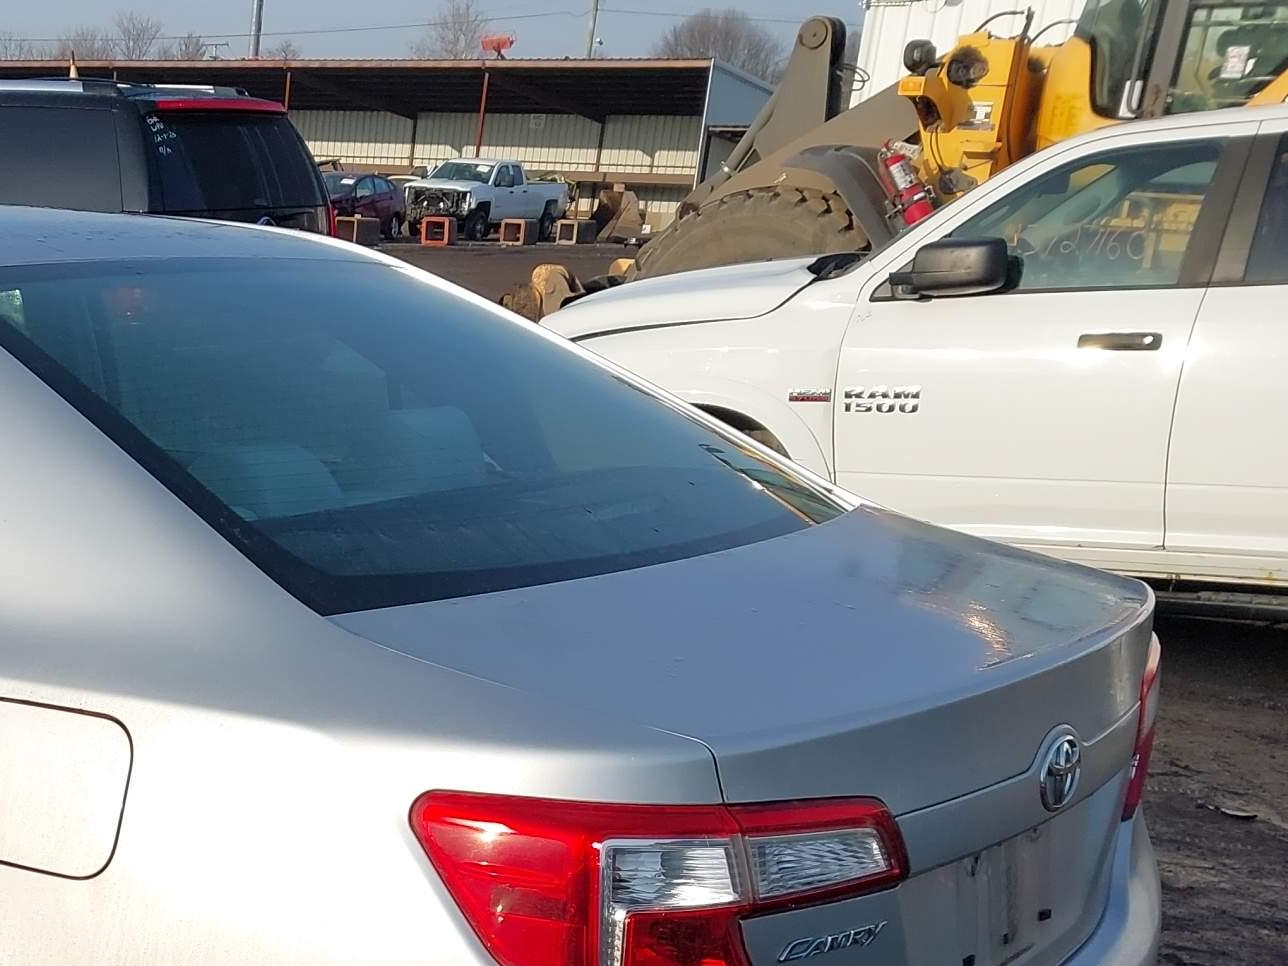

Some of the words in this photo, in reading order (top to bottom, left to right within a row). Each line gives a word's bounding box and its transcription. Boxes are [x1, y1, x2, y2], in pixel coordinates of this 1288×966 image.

[843, 386, 920, 399] RAM
[843, 402, 919, 413] 1500
[778, 920, 888, 962] CAMRY
